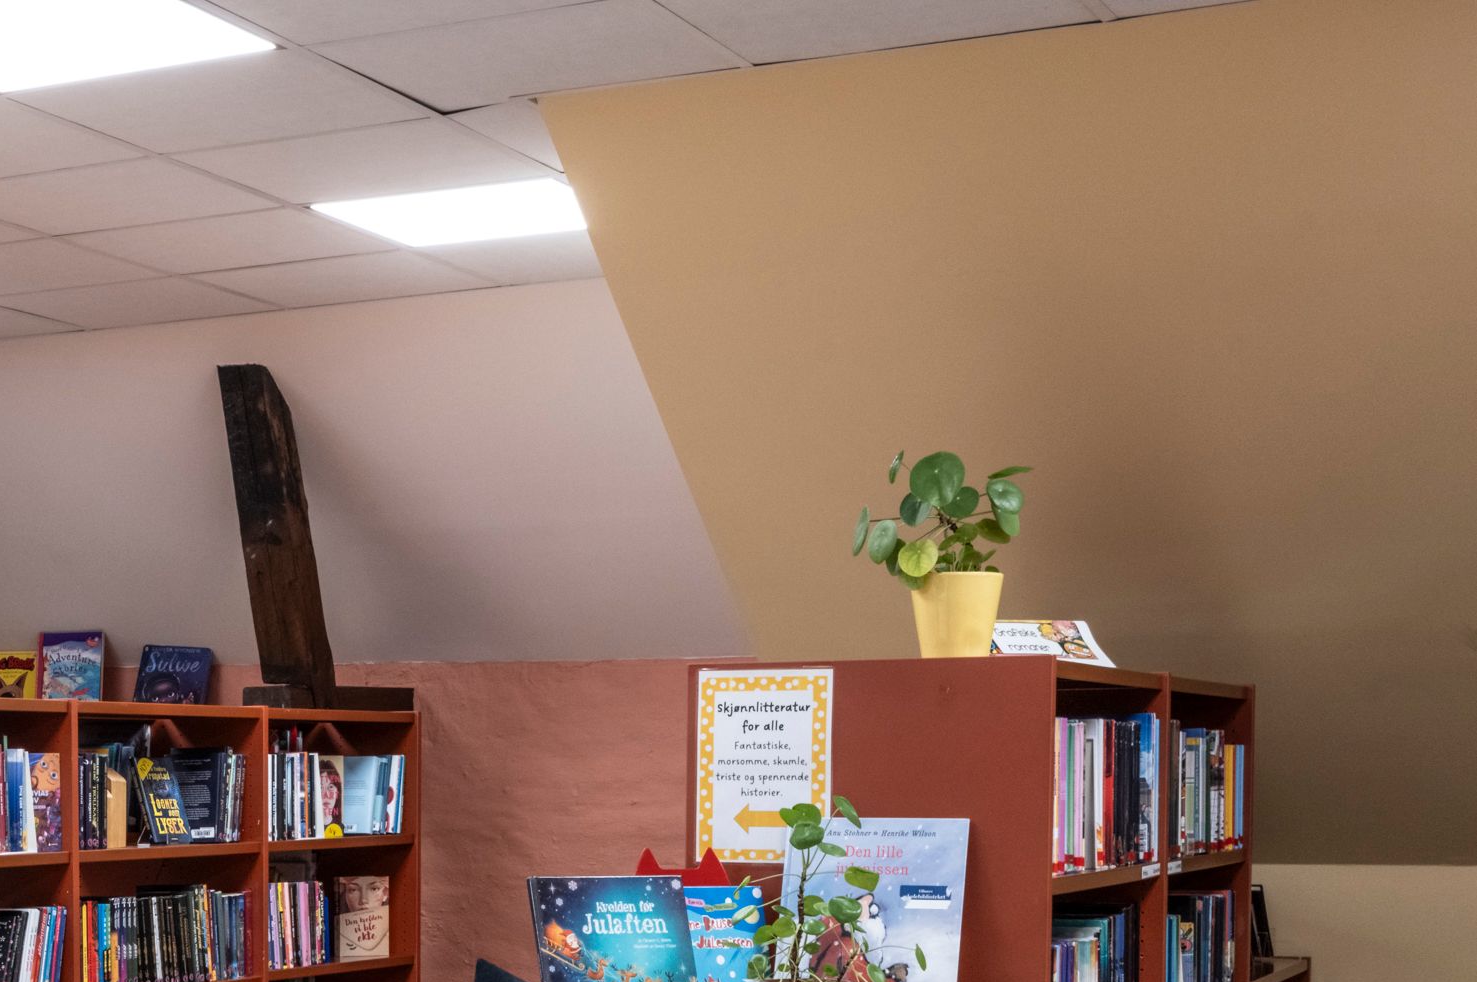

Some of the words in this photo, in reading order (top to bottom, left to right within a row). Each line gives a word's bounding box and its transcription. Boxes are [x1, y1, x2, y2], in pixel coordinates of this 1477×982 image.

[49, 653, 97, 668] Adventure
[145, 652, 201, 674] Sulwe
[742, 720, 759, 734] for
[764, 720, 784, 731] alle
[734, 740, 791, 751] Fantastiske,
[717, 757, 770, 767] morsomme,
[773, 756, 808, 766] skumle,
[716, 772, 741, 781] triste
[744, 774, 755, 784] og
[758, 771, 809, 785] spennende
[740, 788, 784, 797] historier.
[156, 818, 188, 835] LYSER
[844, 829, 871, 837] Stohner
[881, 829, 909, 837] Henrike
[912, 830, 937, 838] Wilson
[845, 845, 871, 858] Den
[876, 845, 904, 858] lille
[596, 901, 637, 913] Kvelden
[639, 900, 655, 913] før
[582, 913, 669, 935] Julaften
[357, 932, 376, 943] ekte
